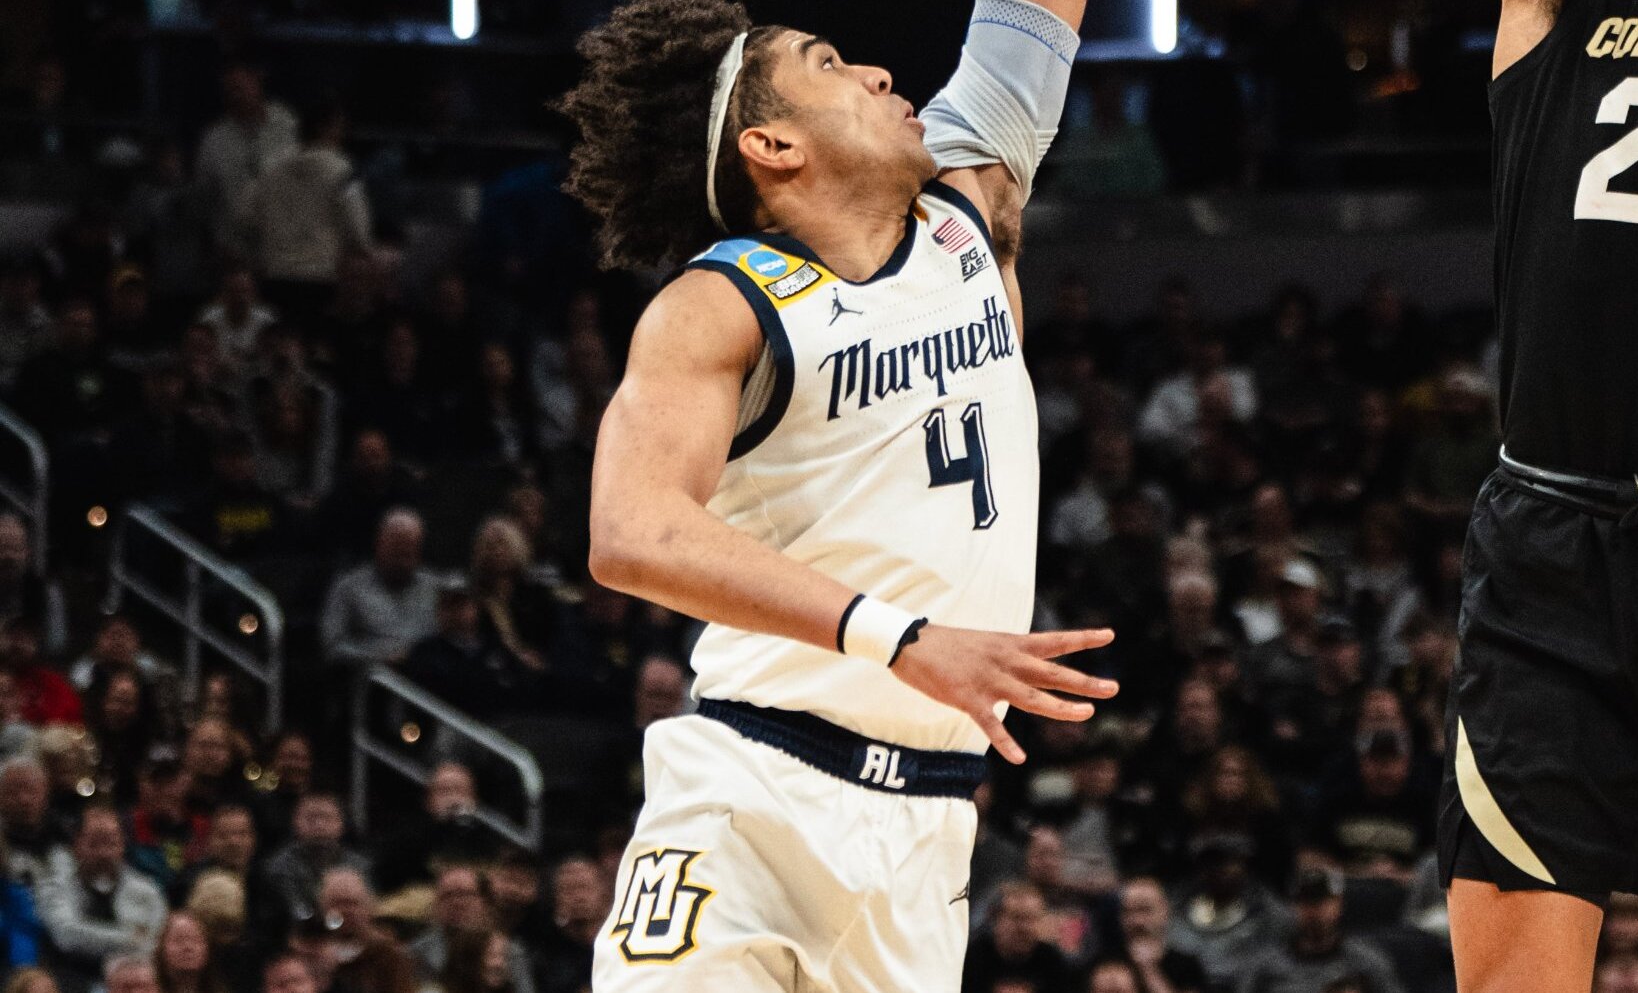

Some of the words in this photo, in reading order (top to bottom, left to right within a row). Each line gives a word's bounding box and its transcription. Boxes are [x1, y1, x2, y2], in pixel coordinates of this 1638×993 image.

[960, 246, 978, 266] BIG
[962, 252, 987, 276] EAST
[818, 295, 1014, 422] Marquette
[922, 402, 998, 531] 4
[612, 849, 717, 966] MU
